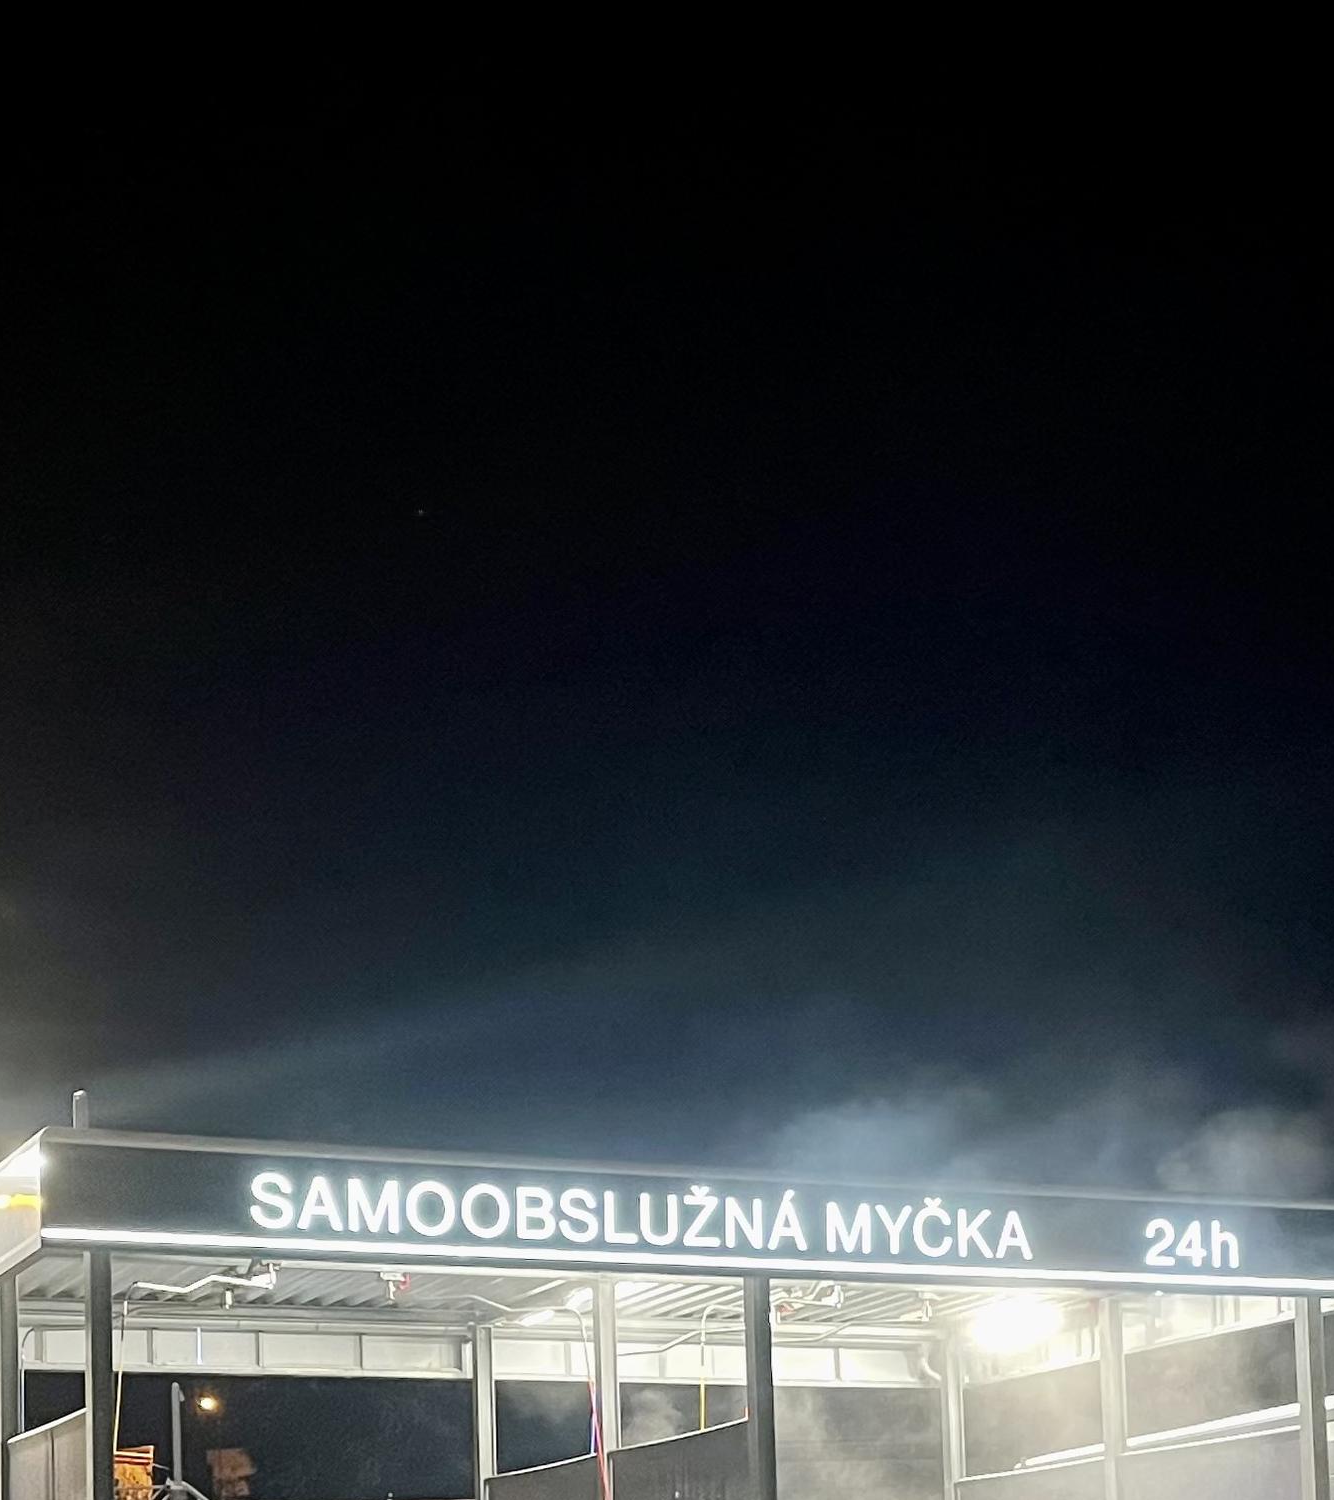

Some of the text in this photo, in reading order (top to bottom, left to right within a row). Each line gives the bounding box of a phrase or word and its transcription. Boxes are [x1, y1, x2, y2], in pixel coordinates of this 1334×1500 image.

[249, 1172, 1034, 1260] SAMOOBSLUŽNÁ MYČKA
[1145, 1218, 1240, 1269] 24h
